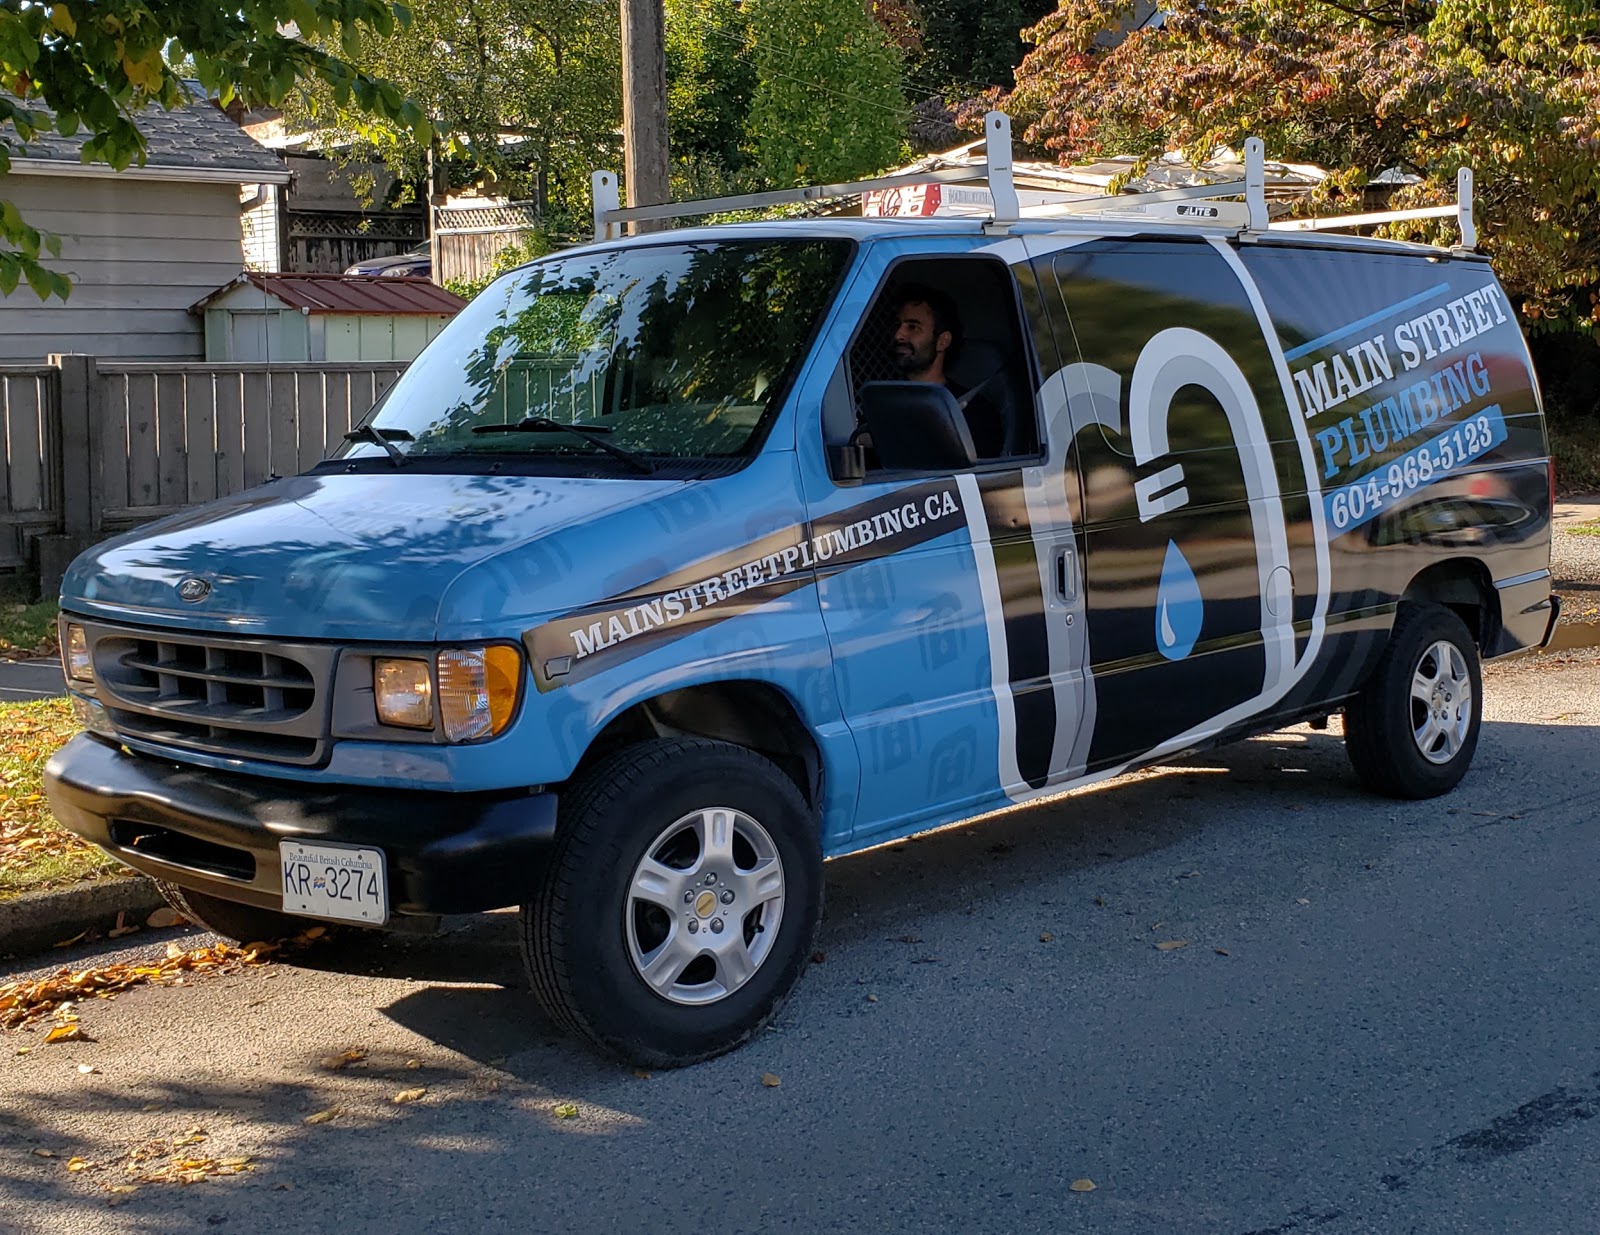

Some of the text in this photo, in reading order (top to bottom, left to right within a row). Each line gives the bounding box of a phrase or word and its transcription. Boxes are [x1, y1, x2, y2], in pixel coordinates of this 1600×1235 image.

[1294, 283, 1507, 419] MAIN STREET
[1315, 351, 1491, 479] PLUMBING
[1331, 415, 1492, 528] 604-968-5123
[569, 490, 959, 659] MAINSTREETPLUMBING.CA
[284, 861, 379, 905] KR 3274
[289, 852, 373, 870] Beautiful British Columbia
